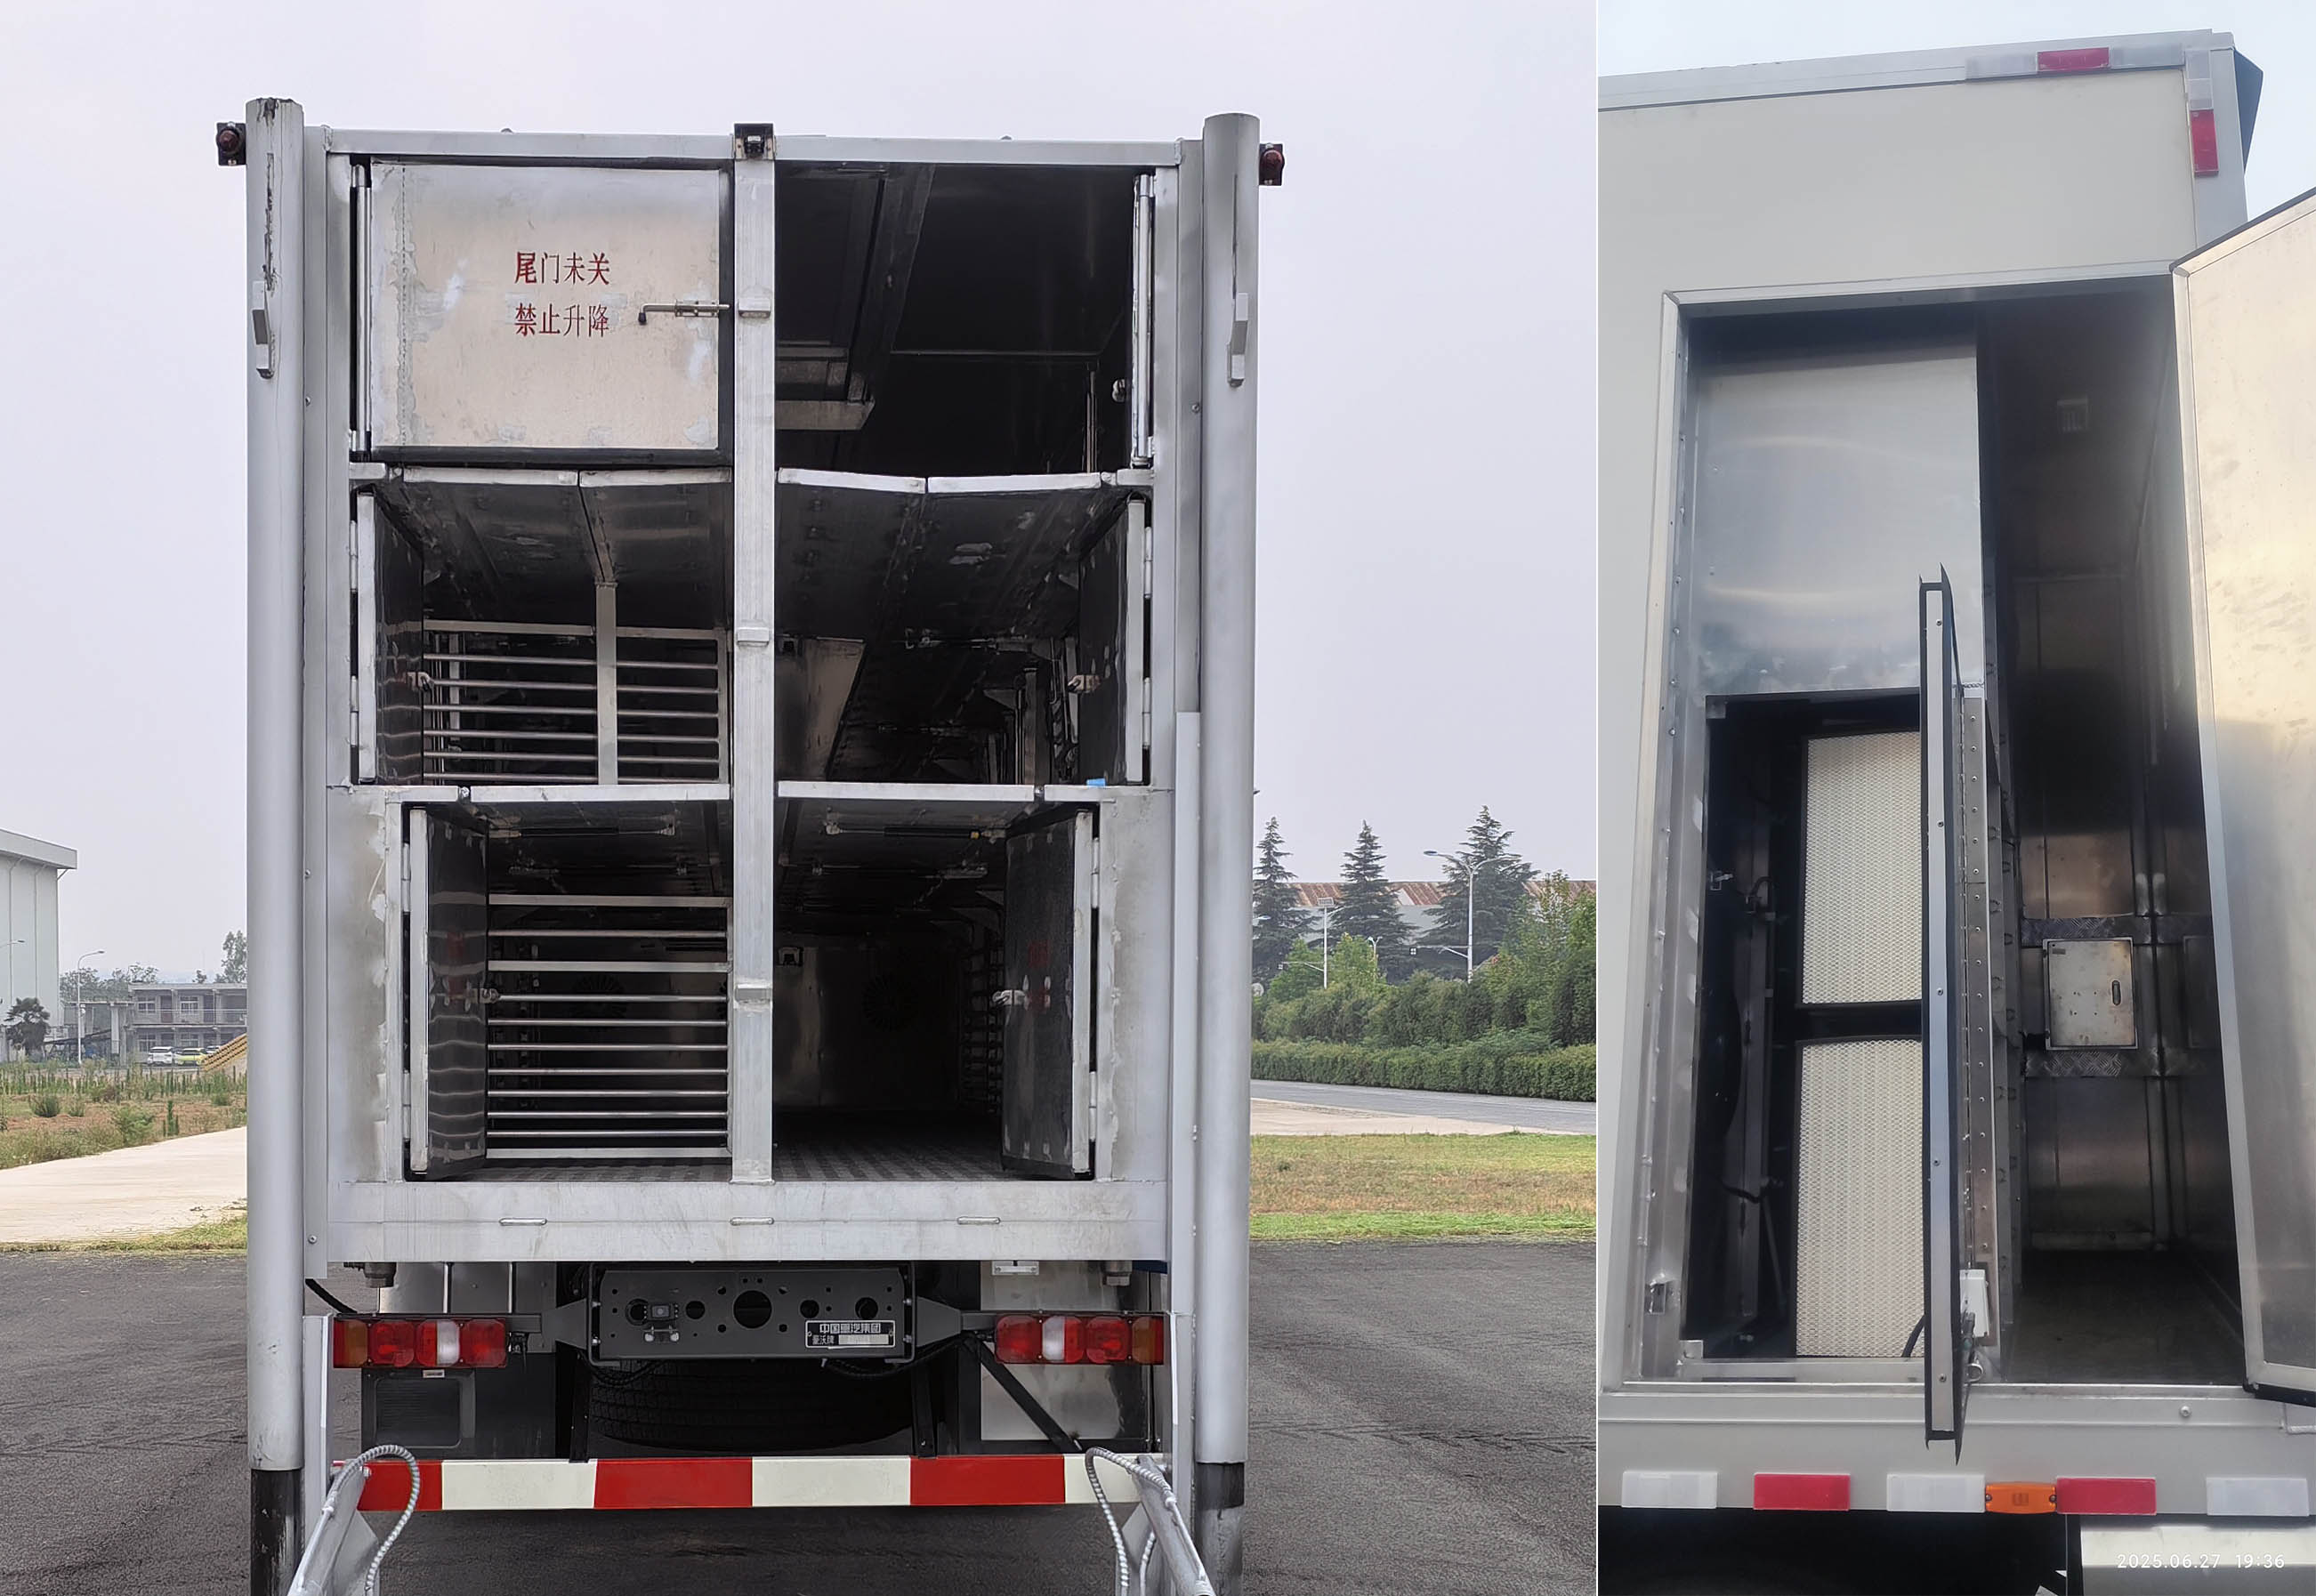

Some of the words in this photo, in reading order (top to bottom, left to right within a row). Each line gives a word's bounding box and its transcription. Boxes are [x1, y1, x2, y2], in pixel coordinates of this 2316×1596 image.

[514, 252, 609, 285] 尾门未关
[514, 302, 609, 337] 禁止升降
